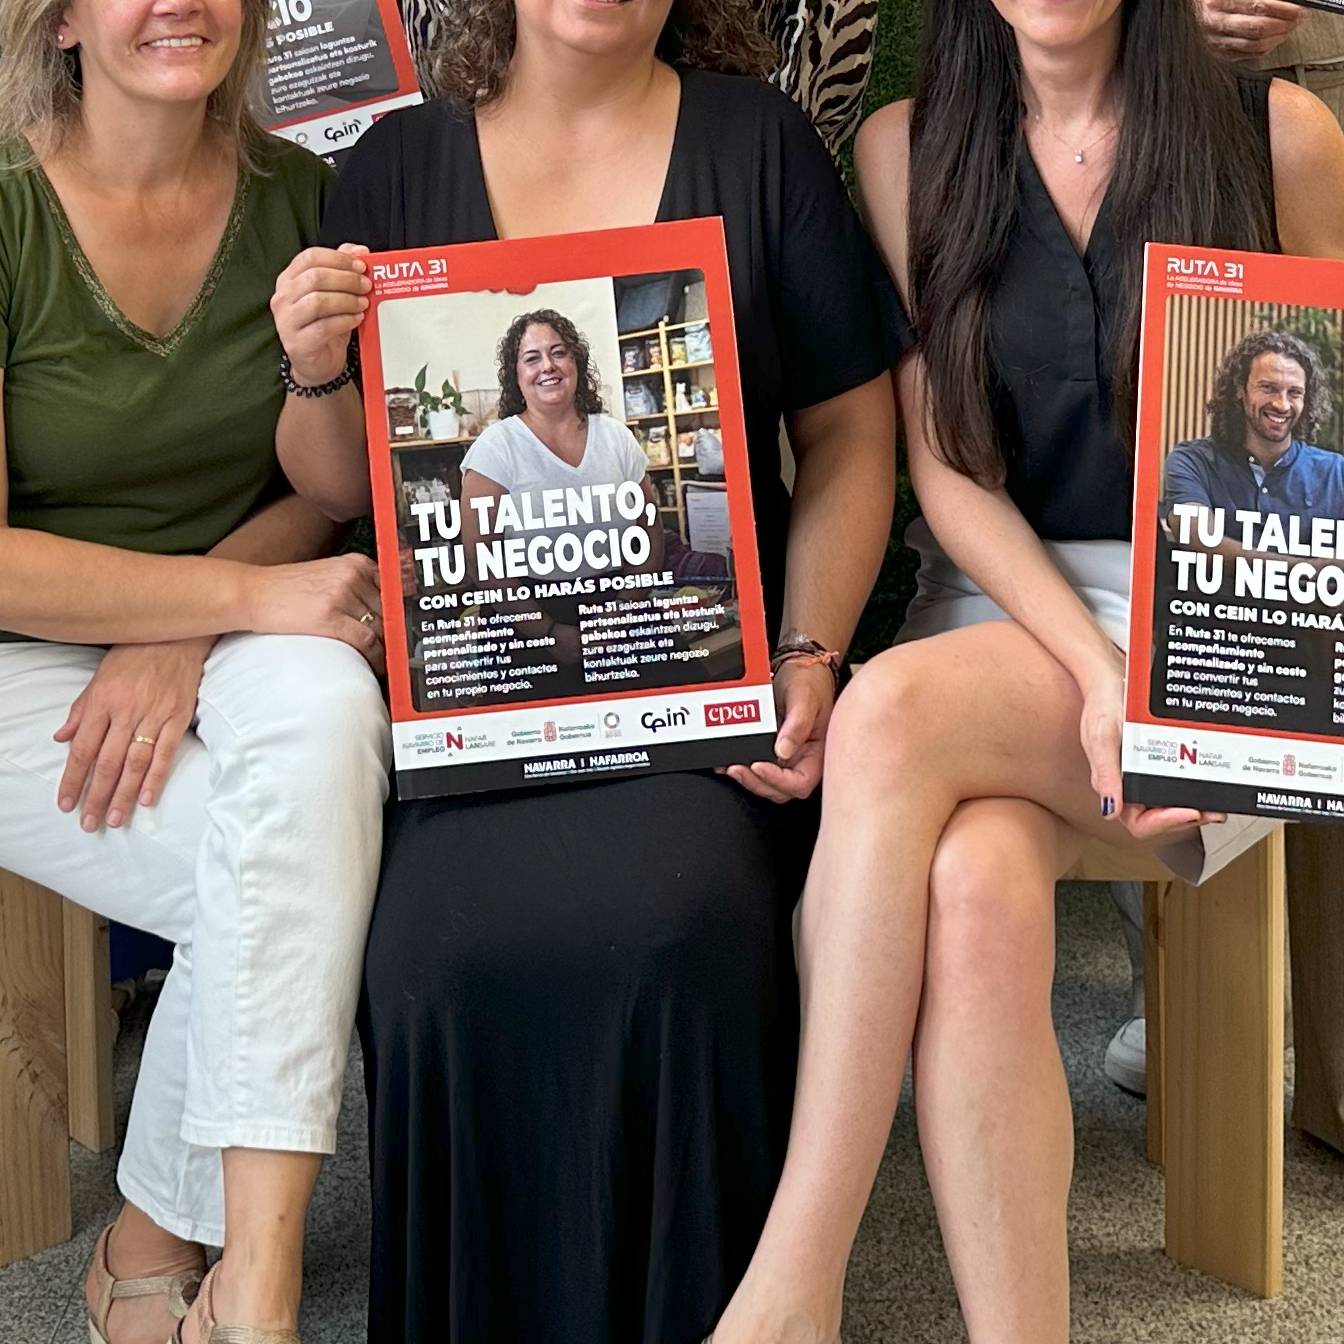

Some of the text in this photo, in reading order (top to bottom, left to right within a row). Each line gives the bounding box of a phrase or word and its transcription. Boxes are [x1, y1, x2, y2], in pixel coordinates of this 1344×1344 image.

[276, 21, 335, 46] POSIBLE
[283, 50, 293, 59] 31
[373, 258, 447, 281] RUTA 31
[1167, 257, 1243, 279] RUTA 31
[410, 480, 656, 542] TU TALENTO,
[1173, 503, 1225, 548] TU
[414, 525, 650, 587] TU NEGOCIO
[1171, 550, 1223, 594] TU
[419, 571, 674, 611] CON CEIN LO HARÁS POSIBLE
[578, 595, 698, 615] Ruta 31 saioan laguntza
[1169, 599, 1210, 618] CON
[1213, 604, 1256, 623] CEIN
[1261, 609, 1287, 625] LO
[421, 611, 542, 632] En Ruta 31 te ofrecemos
[579, 603, 725, 631] pertsonalizatua eta kosturik
[422, 627, 514, 646] acompañamiento
[580, 628, 627, 644] gabekoa
[628, 624, 680, 637] eskaintzen
[1168, 624, 1296, 648] En Ruta 31 te ofrecemos
[423, 636, 555, 660] personalizado y sin coste
[582, 637, 674, 656] zure ezagutzak eta
[583, 646, 710, 669] kontaktuak zeure negozio
[1167, 641, 1264, 659] acompañamiento
[424, 655, 511, 674] para convertir tus
[425, 663, 558, 686] conocimientos y contactos
[584, 667, 640, 683] bihurtzeko.
[1167, 655, 1306, 677] personalizado y sin coste
[1166, 669, 1258, 686] para convertir tus
[426, 679, 533, 699] en tu propio negocio.
[1166, 683, 1305, 705] conocimientos y contactos
[1165, 697, 1277, 717] en tu propio negocio.
[523, 758, 576, 774] NAVARRA
[589, 751, 649, 767] NAFARROA
[1257, 792, 1312, 809] NAVARRA
